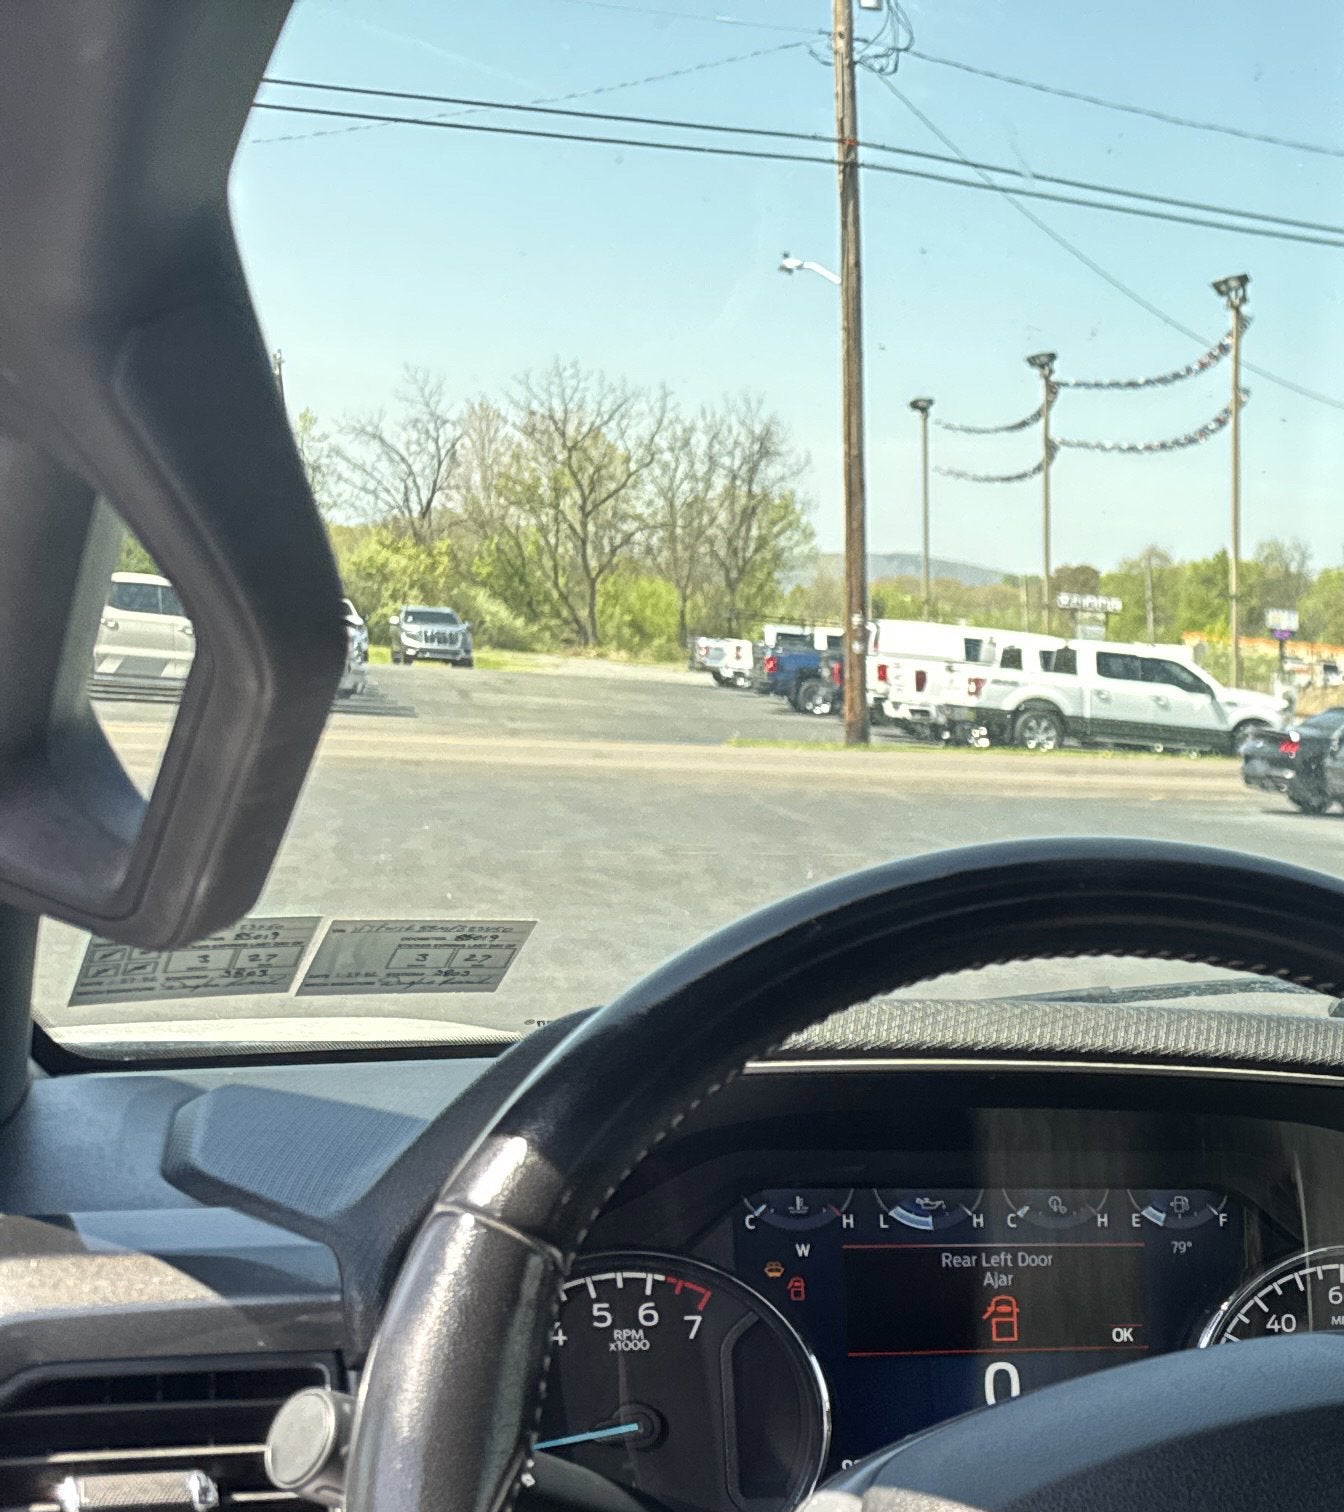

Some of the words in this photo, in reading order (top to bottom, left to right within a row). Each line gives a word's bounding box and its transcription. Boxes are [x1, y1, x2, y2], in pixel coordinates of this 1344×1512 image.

[745, 1215, 756, 1230] C
[843, 1214, 854, 1229] H
[880, 1215, 889, 1229] L
[972, 1214, 984, 1228] H
[1007, 1213, 1017, 1229] C
[1097, 1214, 1108, 1228] H
[1132, 1214, 1141, 1228] E
[1219, 1213, 1228, 1227] F
[795, 1243, 811, 1258] W
[941, 1252, 971, 1268] Rear
[976, 1252, 1012, 1268] Left
[1017, 1251, 1053, 1268] Door
[983, 1272, 1015, 1289] Ajar
[592, 1304, 612, 1327] 5
[638, 1302, 660, 1325] 6
[683, 1316, 702, 1339] 7
[1266, 1313, 1297, 1332] 40
[613, 1329, 645, 1342] RPM
[1112, 1328, 1134, 1343] OK
[609, 1339, 650, 1352] x1000
